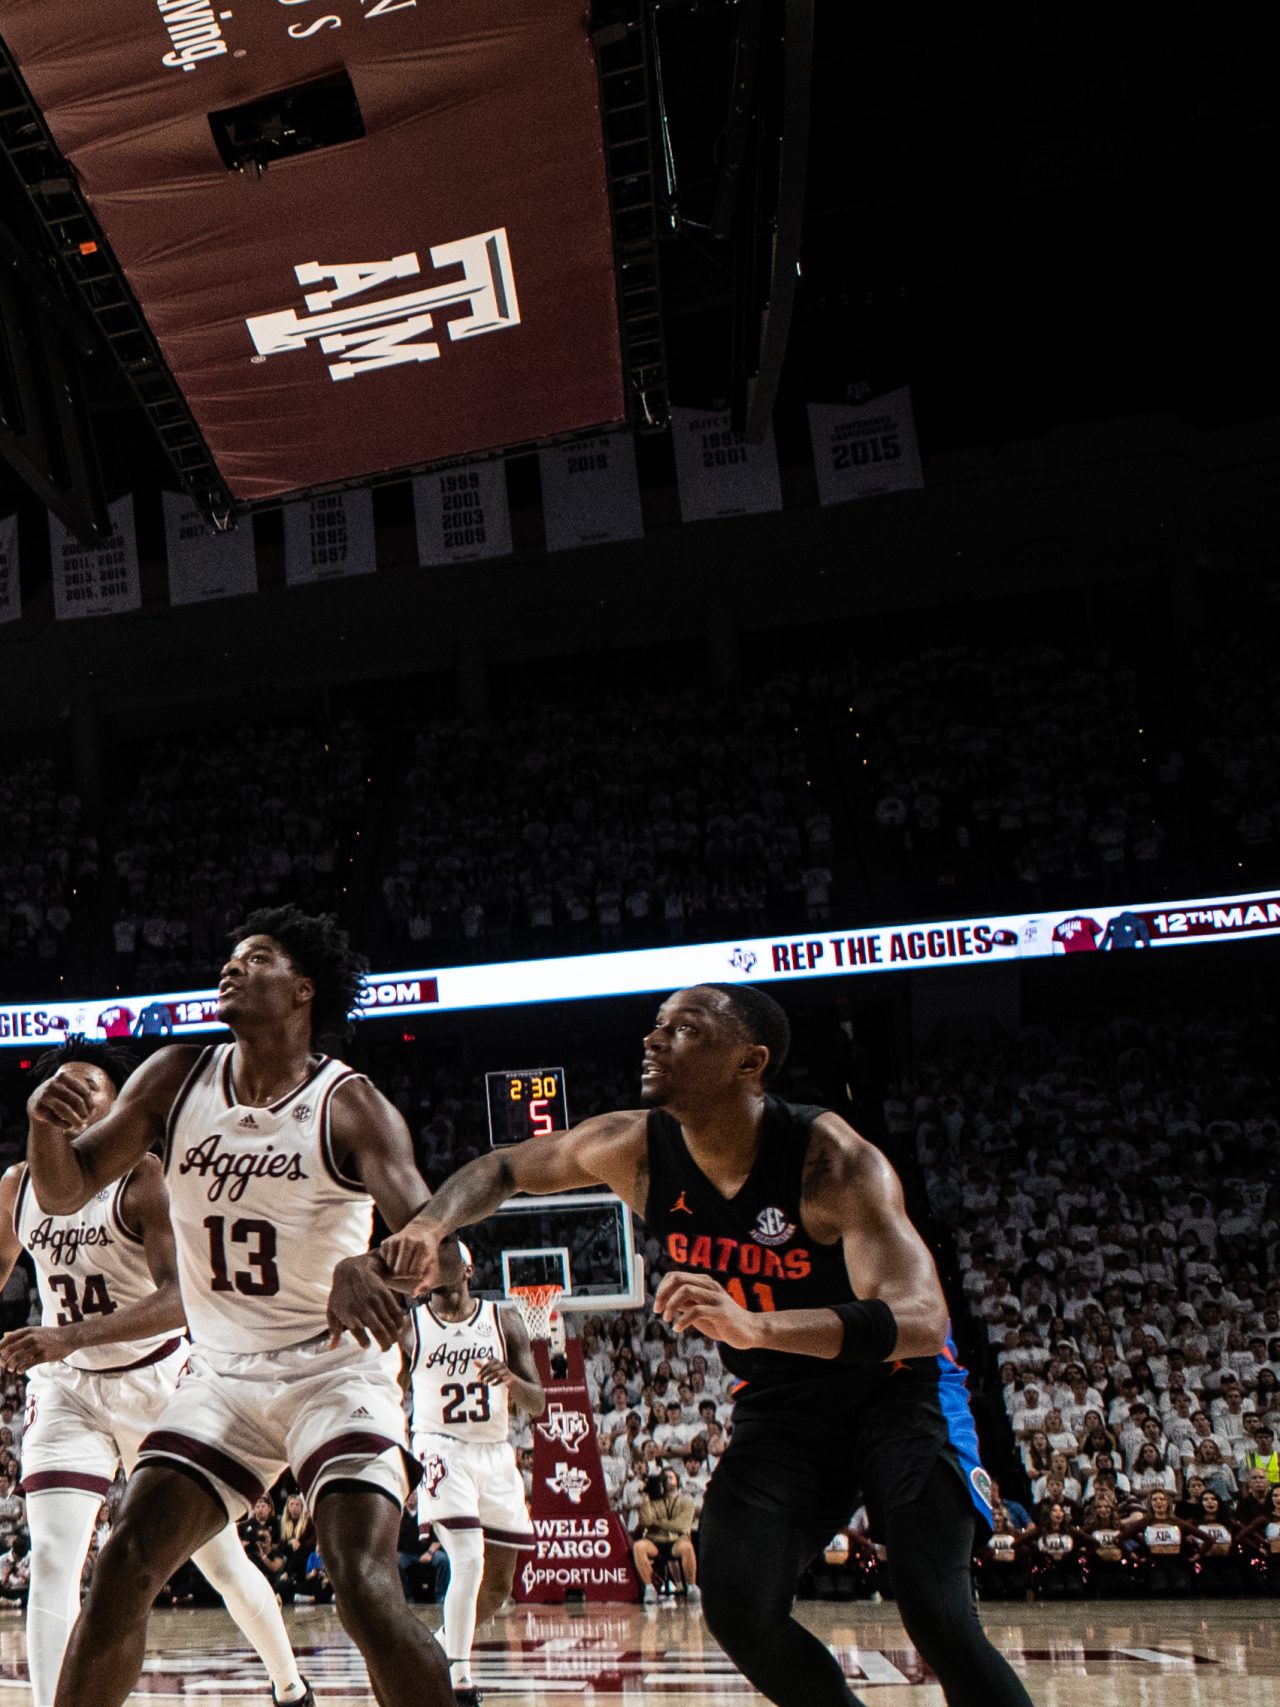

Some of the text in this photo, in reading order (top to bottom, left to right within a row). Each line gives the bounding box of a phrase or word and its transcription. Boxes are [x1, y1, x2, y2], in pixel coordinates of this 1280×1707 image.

[832, 434, 900, 469] 2015
[442, 491, 480, 511] 2001
[771, 941, 824, 972] REP
[829, 934, 883, 968] THE
[889, 925, 994, 962] AGGIES
[510, 1076, 557, 1101] 2:30
[529, 1100, 553, 1136] 5
[180, 1134, 309, 1202] Aggies
[756, 1207, 787, 1235] SEC
[28, 1217, 114, 1266] Aggies
[203, 1216, 280, 1297] 13
[667, 1233, 812, 1280] GATORS
[48, 1273, 118, 1326] 34
[426, 1343, 495, 1377] Aggies
[440, 1382, 491, 1424] 23
[534, 1518, 610, 1538] WELLS
[536, 1540, 612, 1560] FARGO
[522, 1561, 629, 1596] OPPORTUNE
